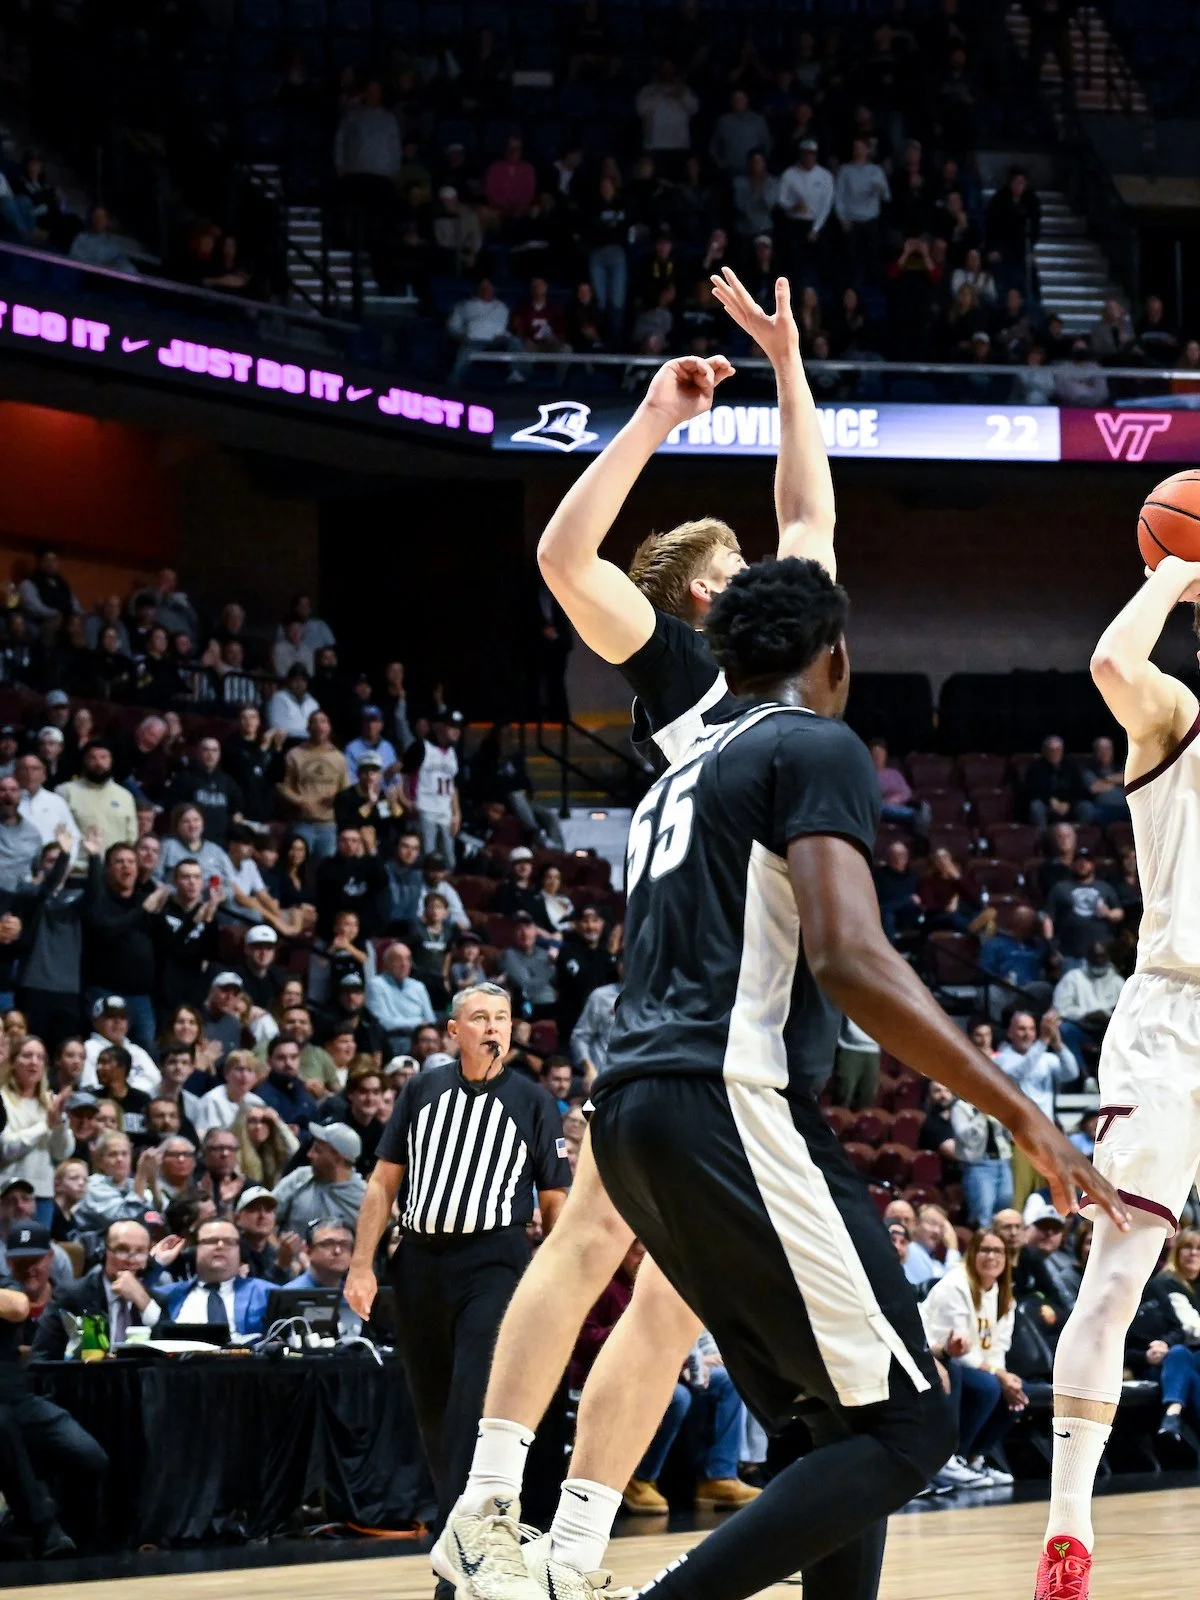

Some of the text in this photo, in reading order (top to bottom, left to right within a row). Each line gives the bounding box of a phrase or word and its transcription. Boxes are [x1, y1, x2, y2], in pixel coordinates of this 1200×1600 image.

[12, 304, 68, 343] DO
[71, 317, 110, 352] IT
[157, 338, 344, 402] JUST DO IT
[377, 387, 494, 434] JUST D
[665, 405, 879, 449] ROVINCE
[984, 414, 1041, 454] 22
[1094, 412, 1173, 461] VT
[626, 762, 704, 904] 55
